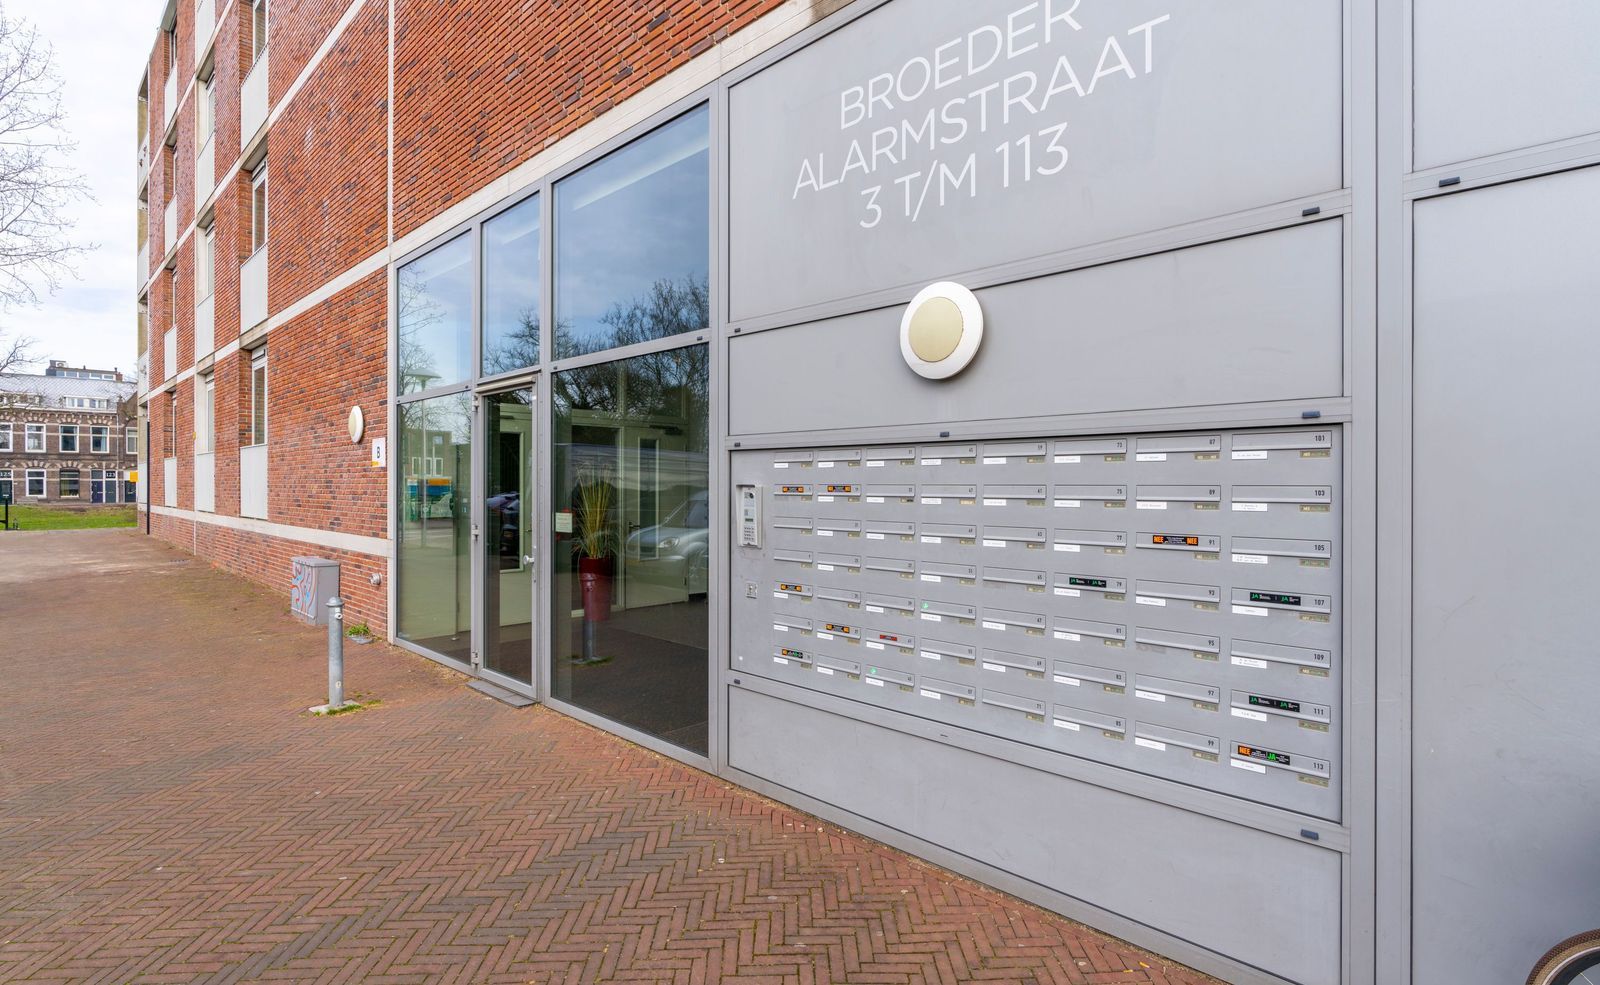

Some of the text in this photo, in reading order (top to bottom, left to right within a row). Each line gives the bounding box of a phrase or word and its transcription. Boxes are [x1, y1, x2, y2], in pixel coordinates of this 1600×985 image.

[792, 13, 1170, 200] ALARMSTRAAT
[840, 0, 1082, 130] BROEDER
[859, 122, 1068, 228] 3 T/M 113
